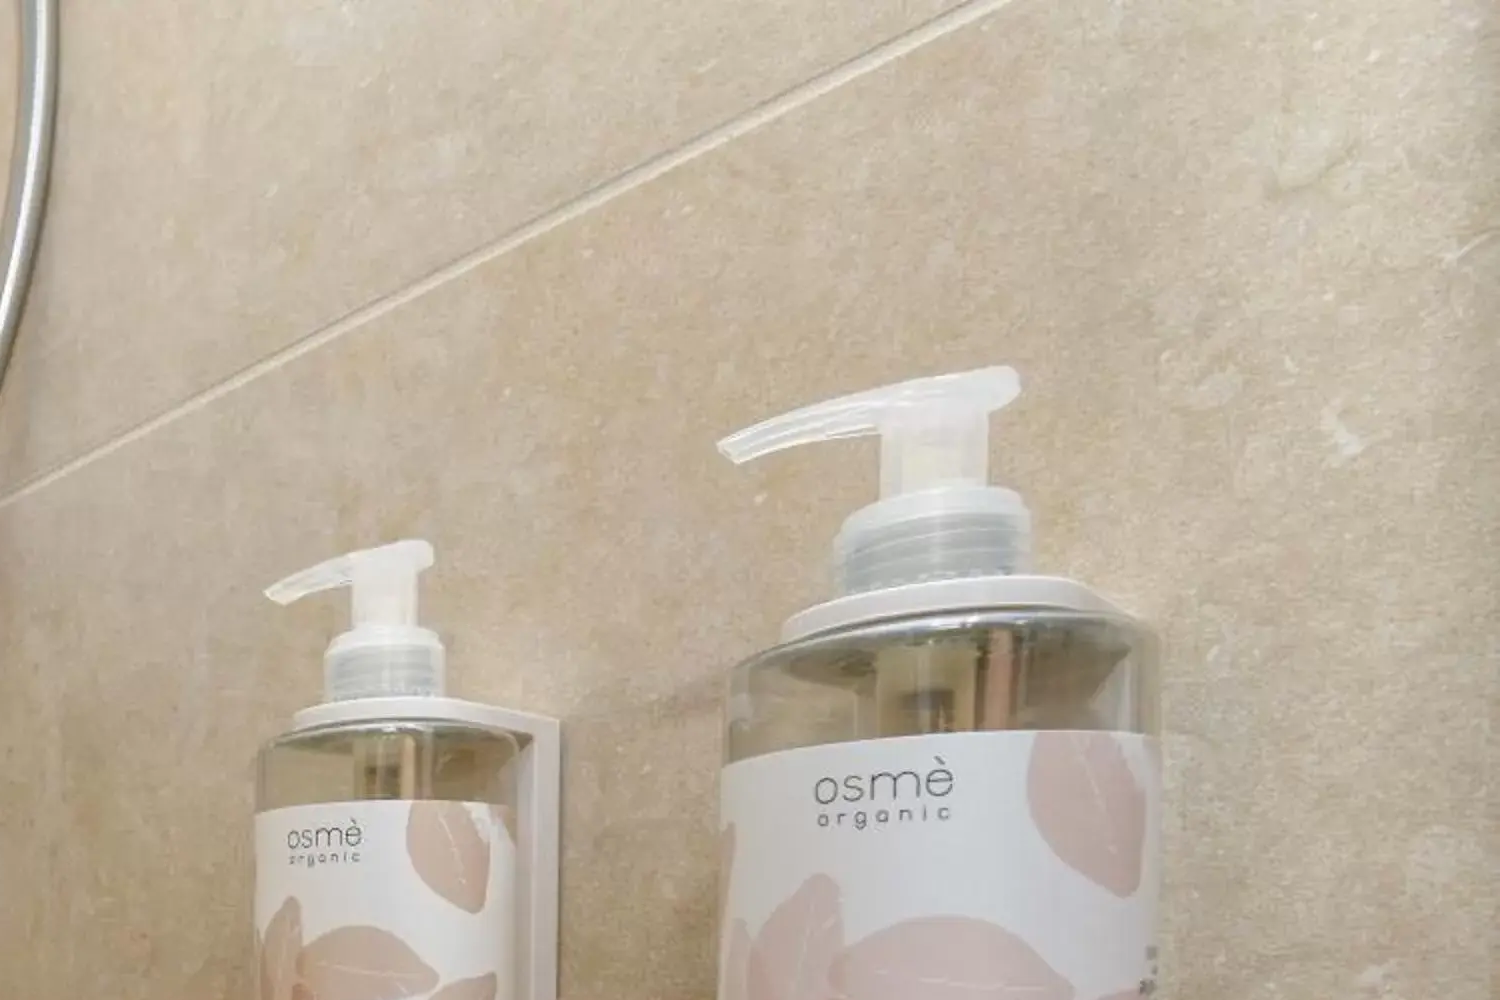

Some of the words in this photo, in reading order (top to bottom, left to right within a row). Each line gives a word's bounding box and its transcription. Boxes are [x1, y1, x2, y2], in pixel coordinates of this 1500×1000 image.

[815, 755, 953, 804] osmè
[287, 816, 362, 849] osmè
[817, 805, 949, 831] organic
[289, 851, 360, 868] organic
